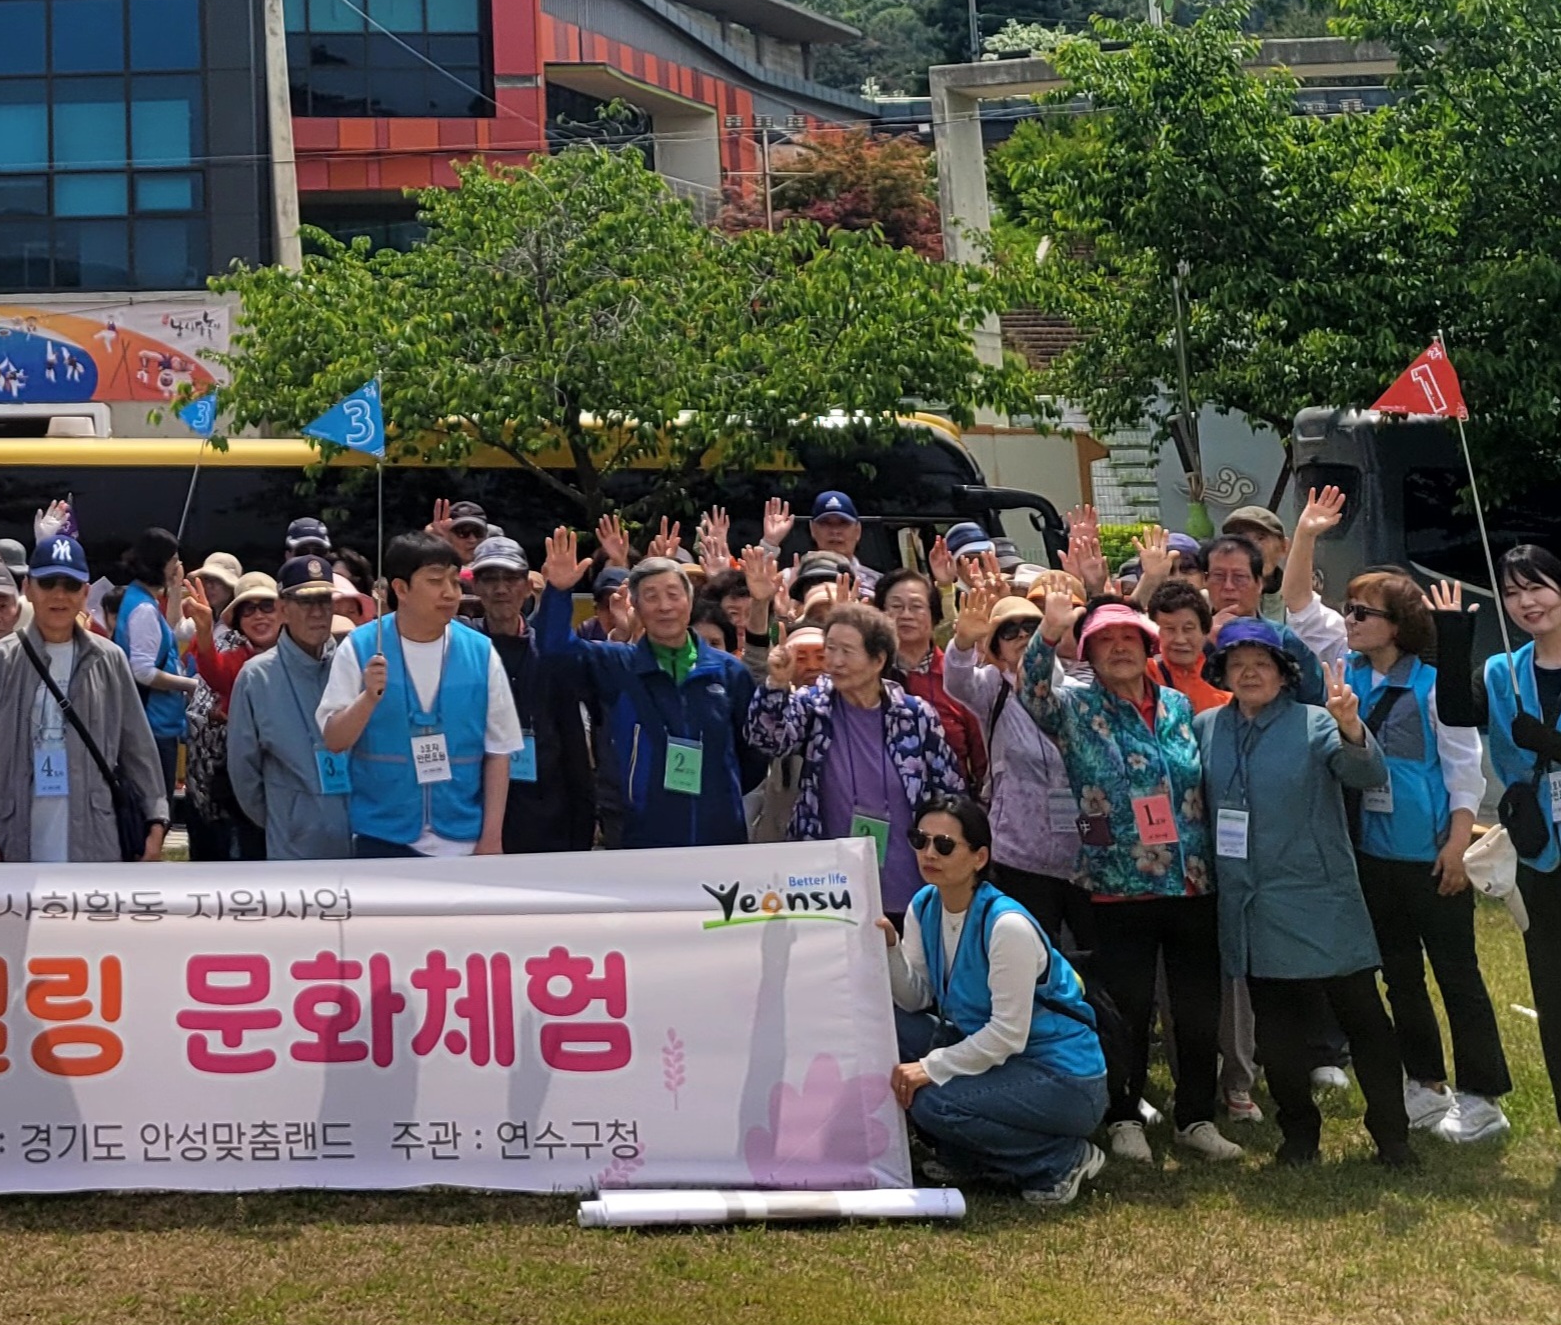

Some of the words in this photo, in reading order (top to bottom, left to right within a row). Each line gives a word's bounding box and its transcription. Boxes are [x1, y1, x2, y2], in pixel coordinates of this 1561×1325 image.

[1410, 363, 1448, 414] 1
[343, 399, 375, 445] 3
[701, 880, 852, 922] Yeonsu
[788, 875, 826, 887] Better
[828, 873, 848, 885] life
[185, 887, 354, 922] 지원사업
[175, 945, 633, 1075] 문화체험
[20, 1123, 126, 1164] 경기도
[140, 1121, 356, 1164] 안성맞춤랜드
[496, 1117, 640, 1161] 연수구청
